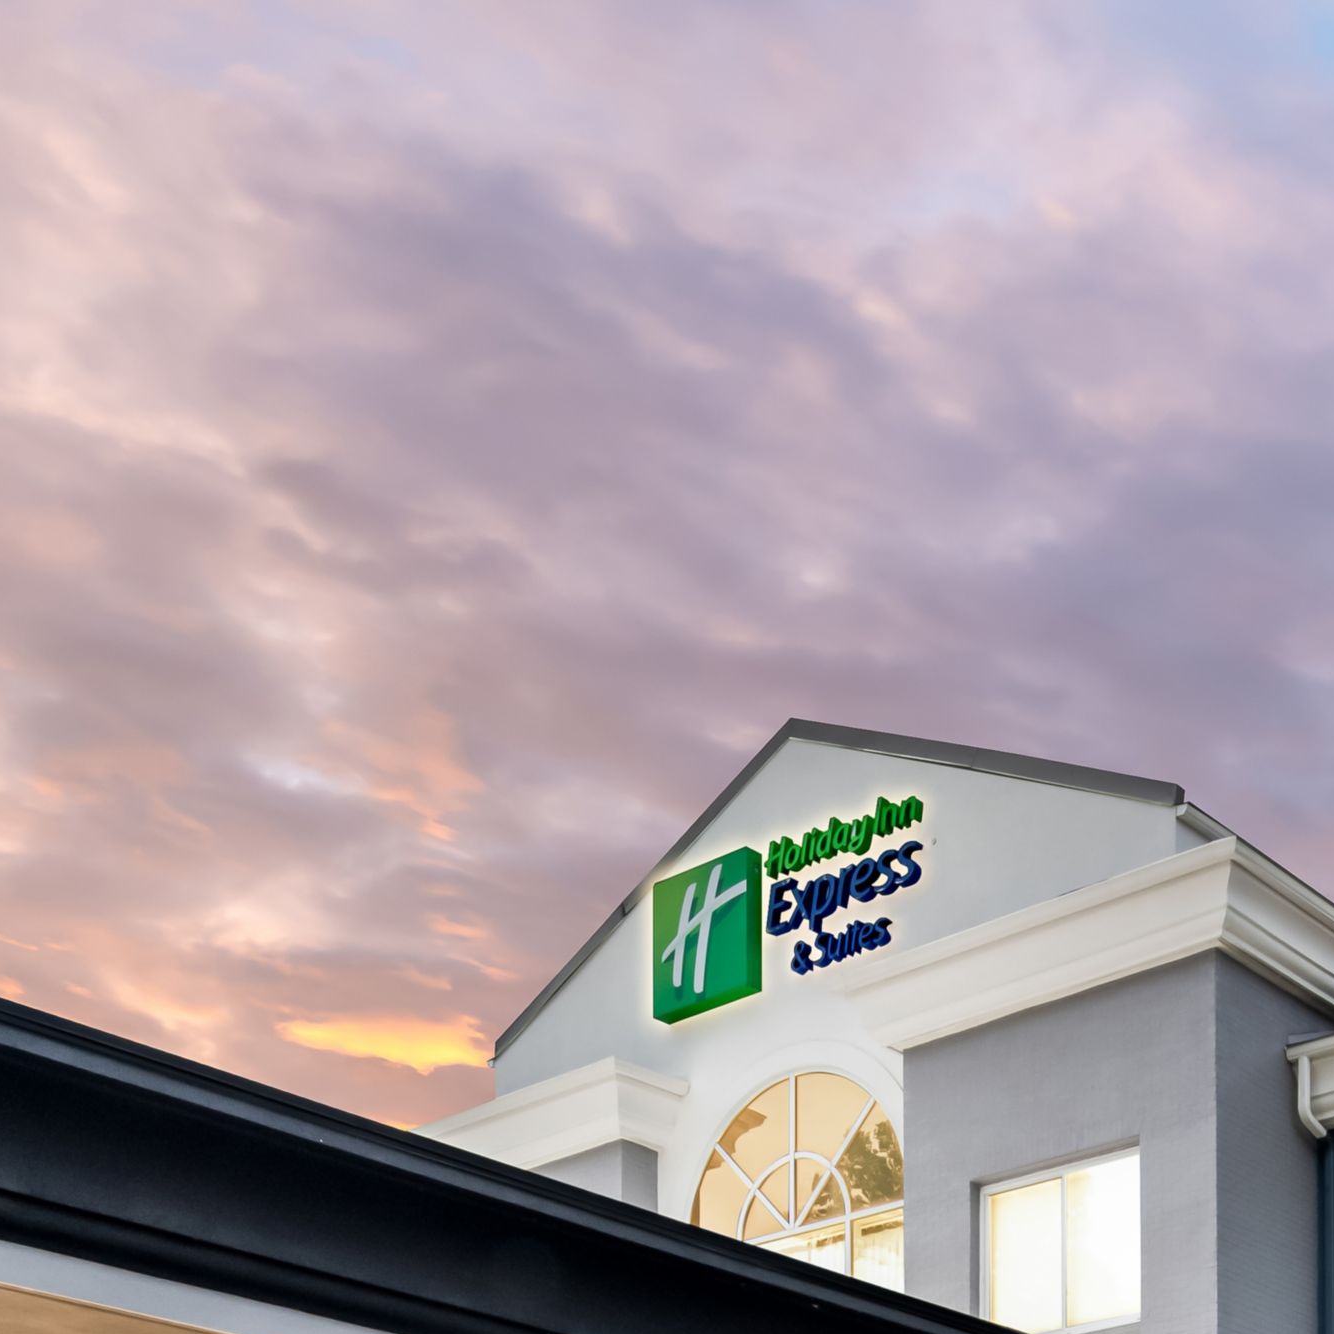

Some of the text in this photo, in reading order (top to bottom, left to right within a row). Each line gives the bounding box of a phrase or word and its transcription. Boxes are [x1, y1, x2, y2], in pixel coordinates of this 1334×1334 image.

[764, 796, 923, 880] Holiday Inn
[766, 841, 923, 936] Express
[791, 917, 893, 975] & Suites
